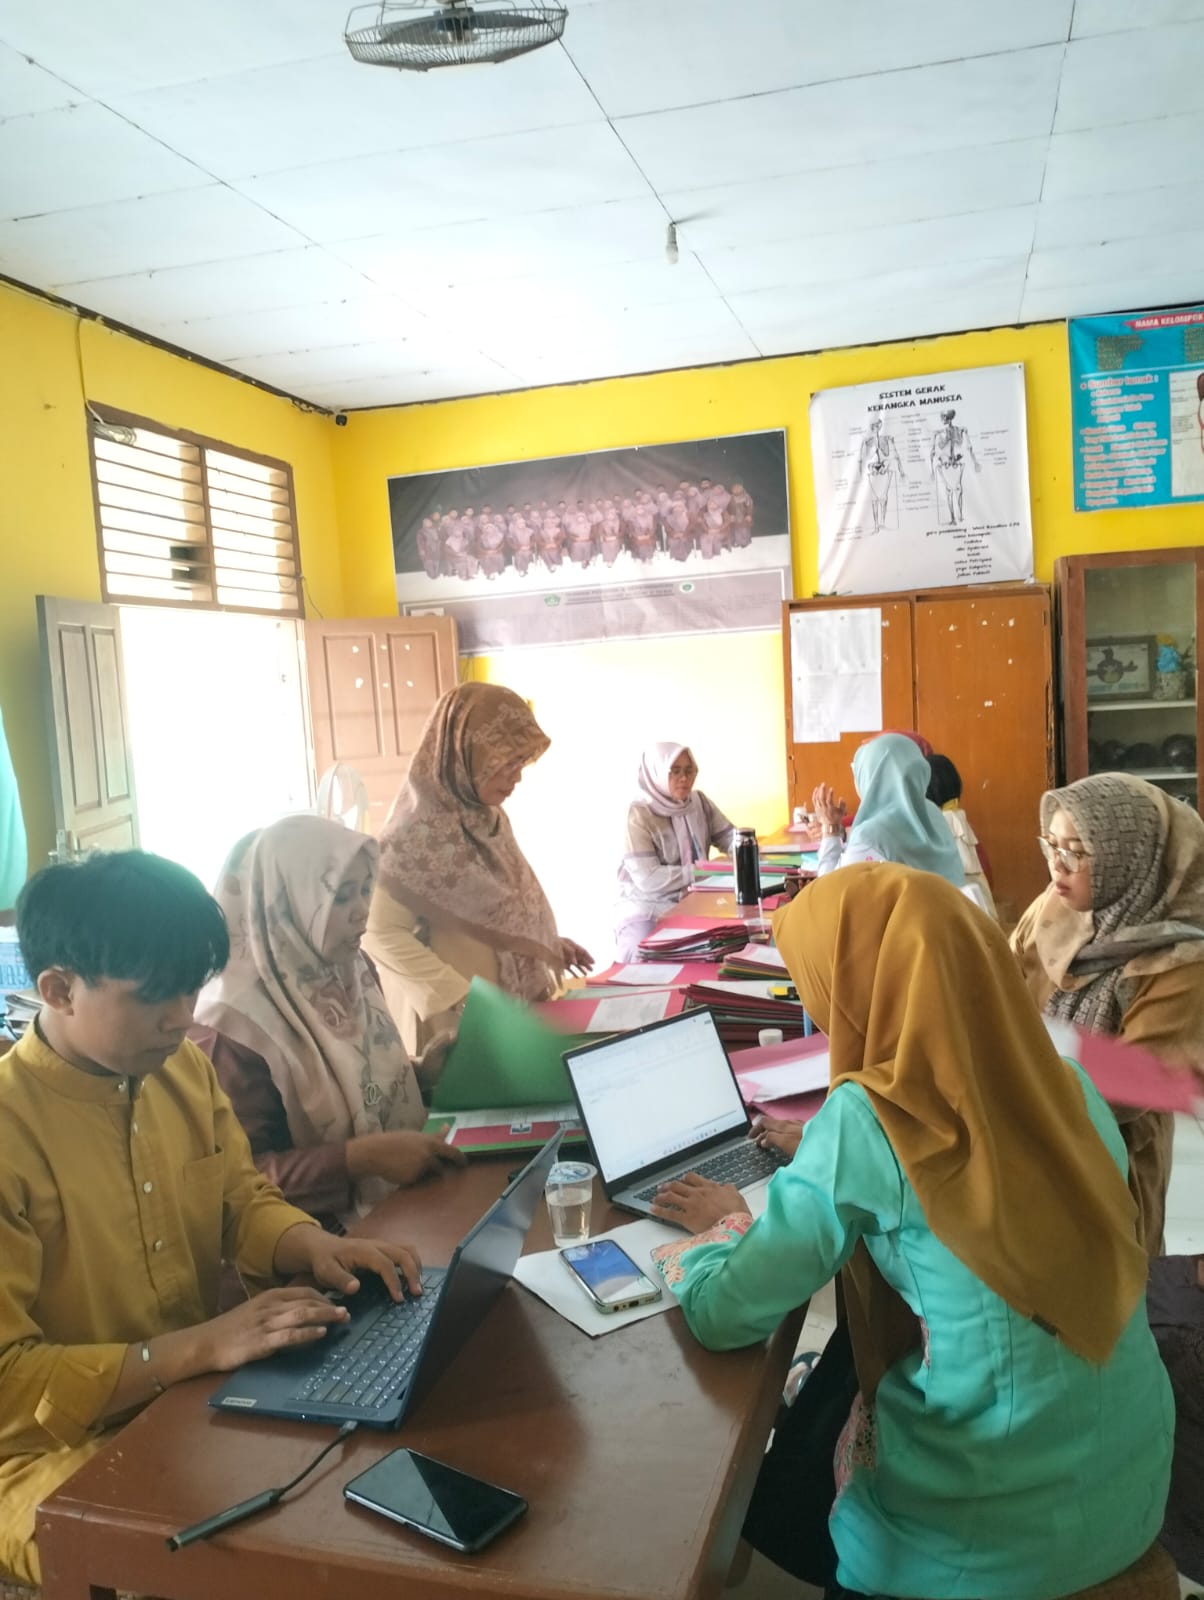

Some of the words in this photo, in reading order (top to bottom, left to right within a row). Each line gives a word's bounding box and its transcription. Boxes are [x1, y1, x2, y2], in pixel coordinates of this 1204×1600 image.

[1135, 318, 1159, 328] NAMA
[879, 389, 912, 399] SISTEM
[915, 384, 946, 394] GERAK
[867, 400, 916, 412] KERANGKA
[919, 394, 963, 406] MANUSIA
